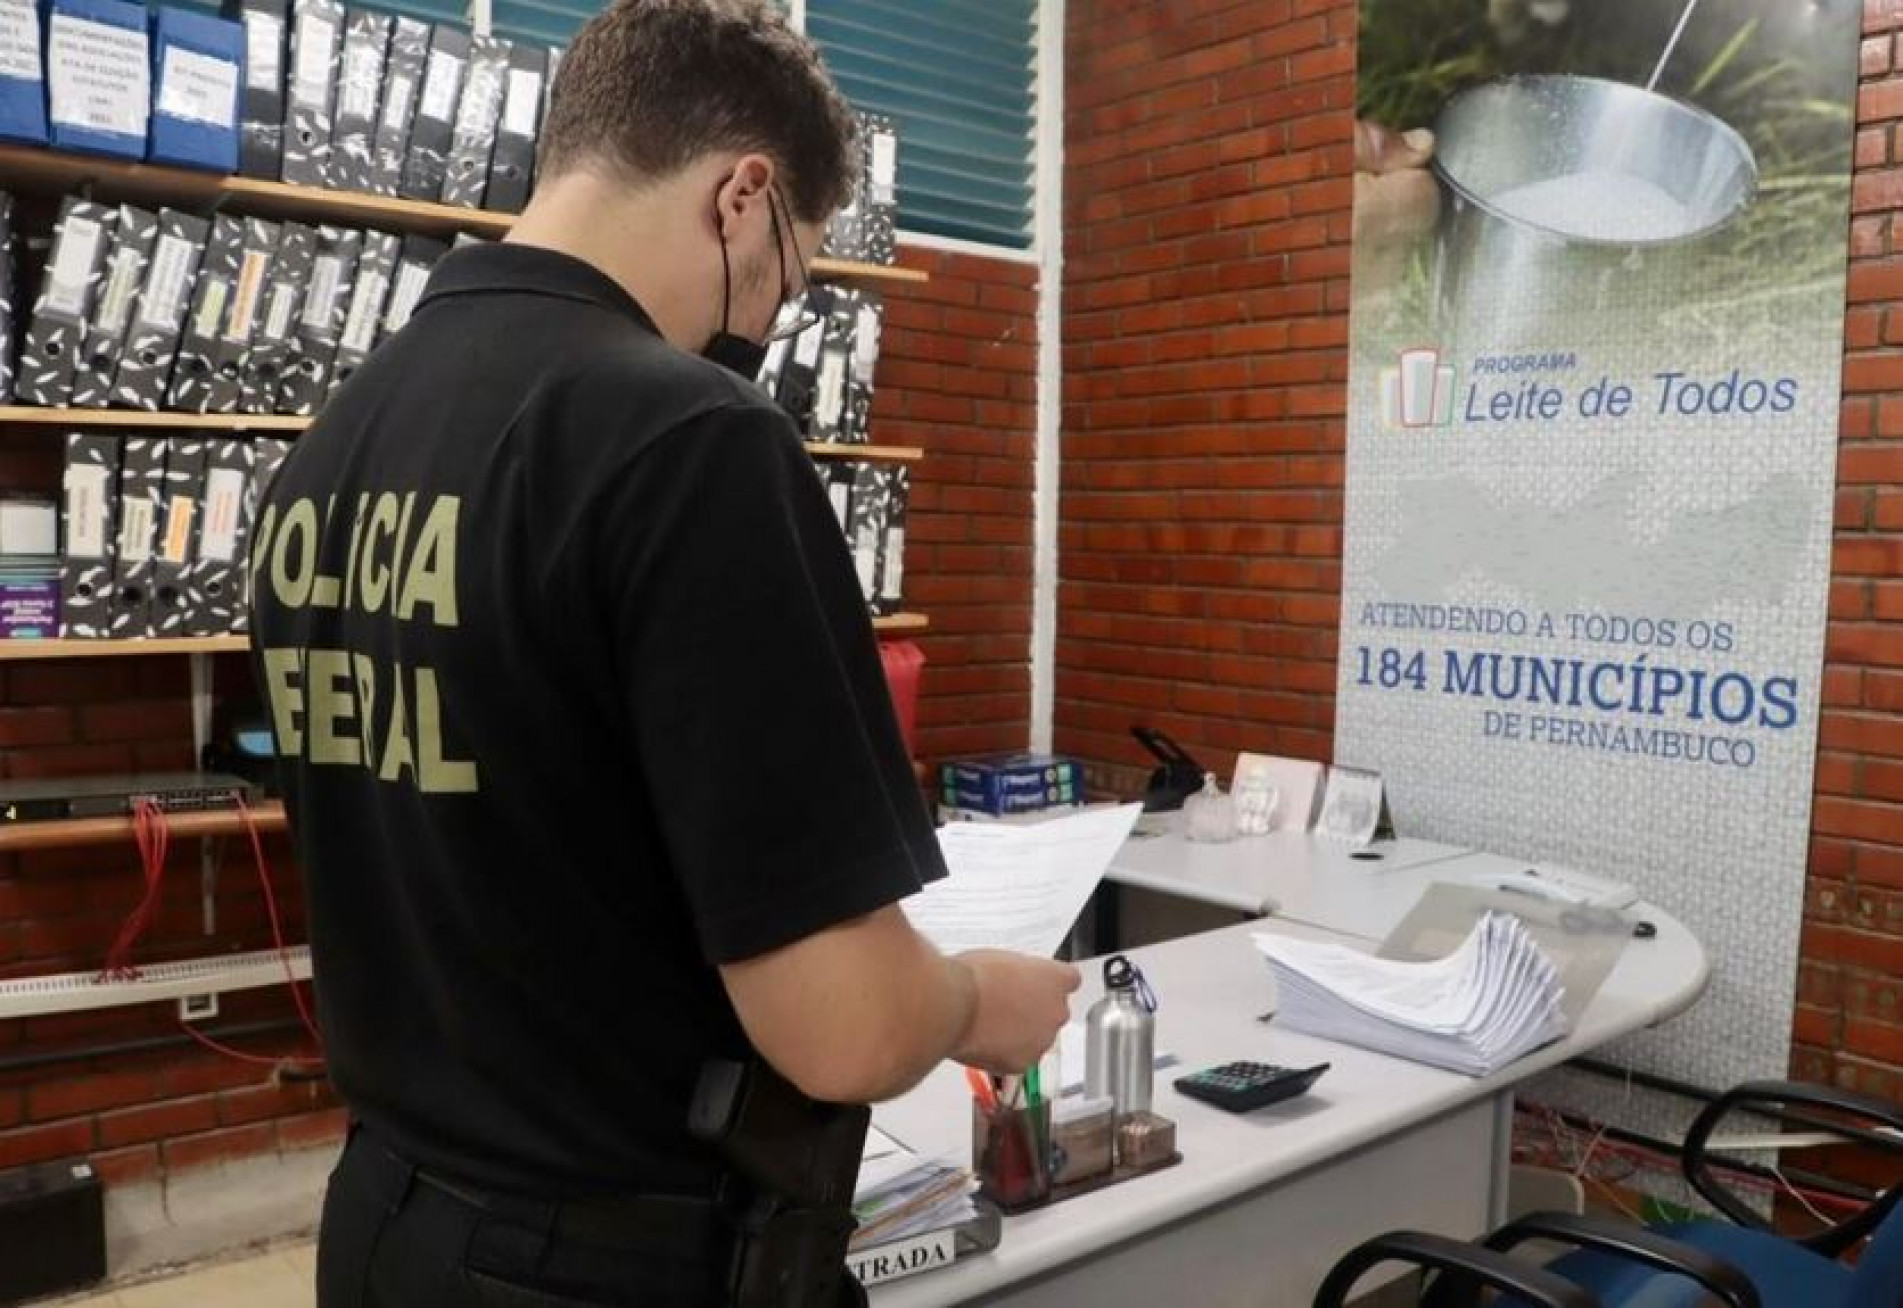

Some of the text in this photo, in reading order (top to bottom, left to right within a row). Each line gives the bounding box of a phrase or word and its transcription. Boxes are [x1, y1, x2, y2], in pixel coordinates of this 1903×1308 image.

[1473, 353, 1577, 374] PROGRAMA
[1465, 369, 1799, 422] Leite de Todos
[1360, 602, 1734, 652] ATENDENDO A TODOS OS
[1356, 646, 1798, 729] 184 MUNICÍPIOS
[1482, 711, 1757, 768] DE PERNAMBUCO
[854, 1243, 946, 1280] TRADA
